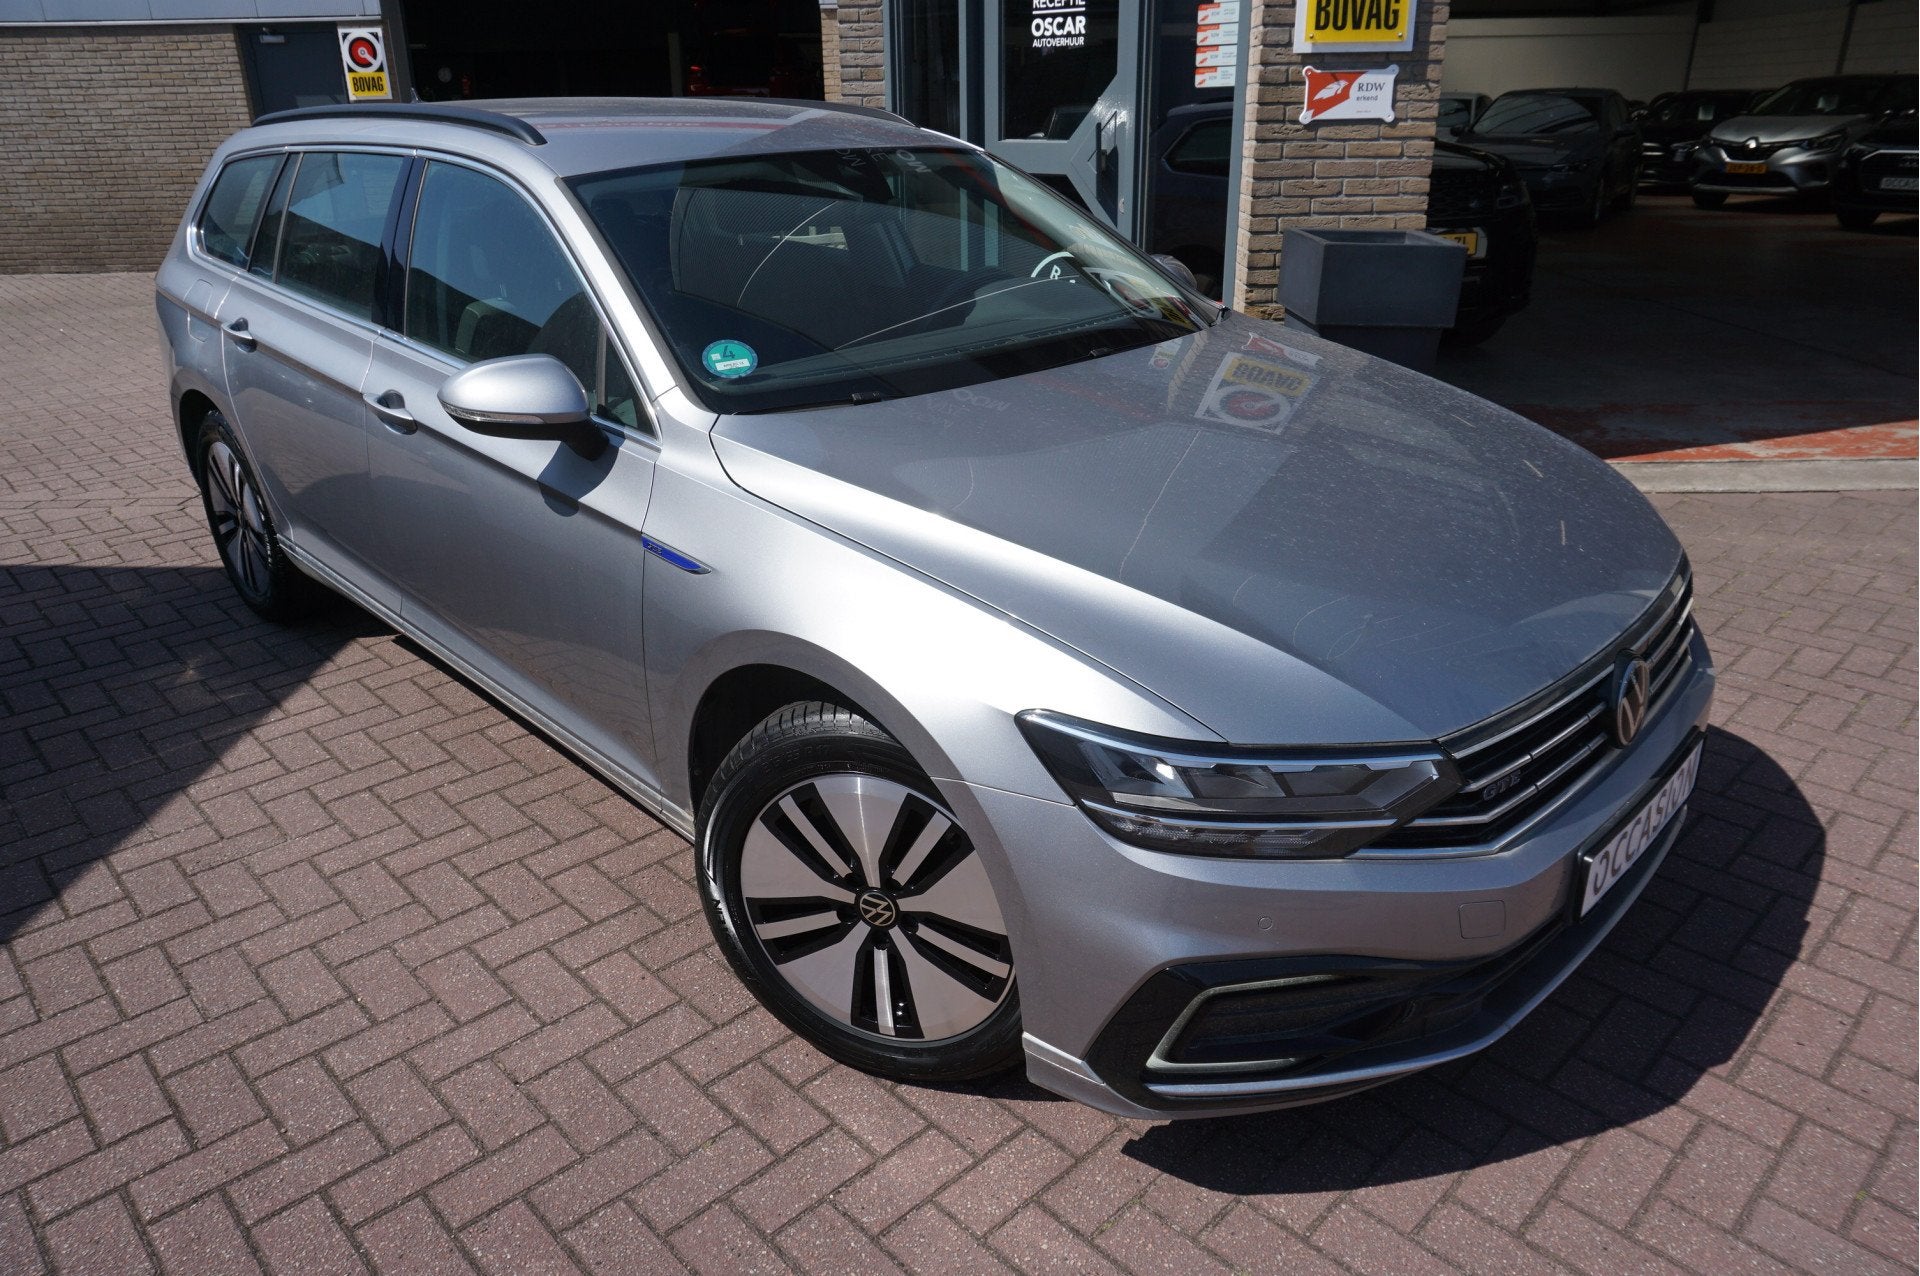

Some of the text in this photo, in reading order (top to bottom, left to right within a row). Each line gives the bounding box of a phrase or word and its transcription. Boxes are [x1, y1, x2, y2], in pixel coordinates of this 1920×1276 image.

[1314, 0, 1400, 31] BOVAG
[1031, 15, 1086, 37] OSCAR
[1032, 36, 1085, 48] AUTOVERHUUR
[352, 76, 384, 92] BOVAG
[1357, 82, 1386, 92] RDW
[723, 345, 736, 358] 4
